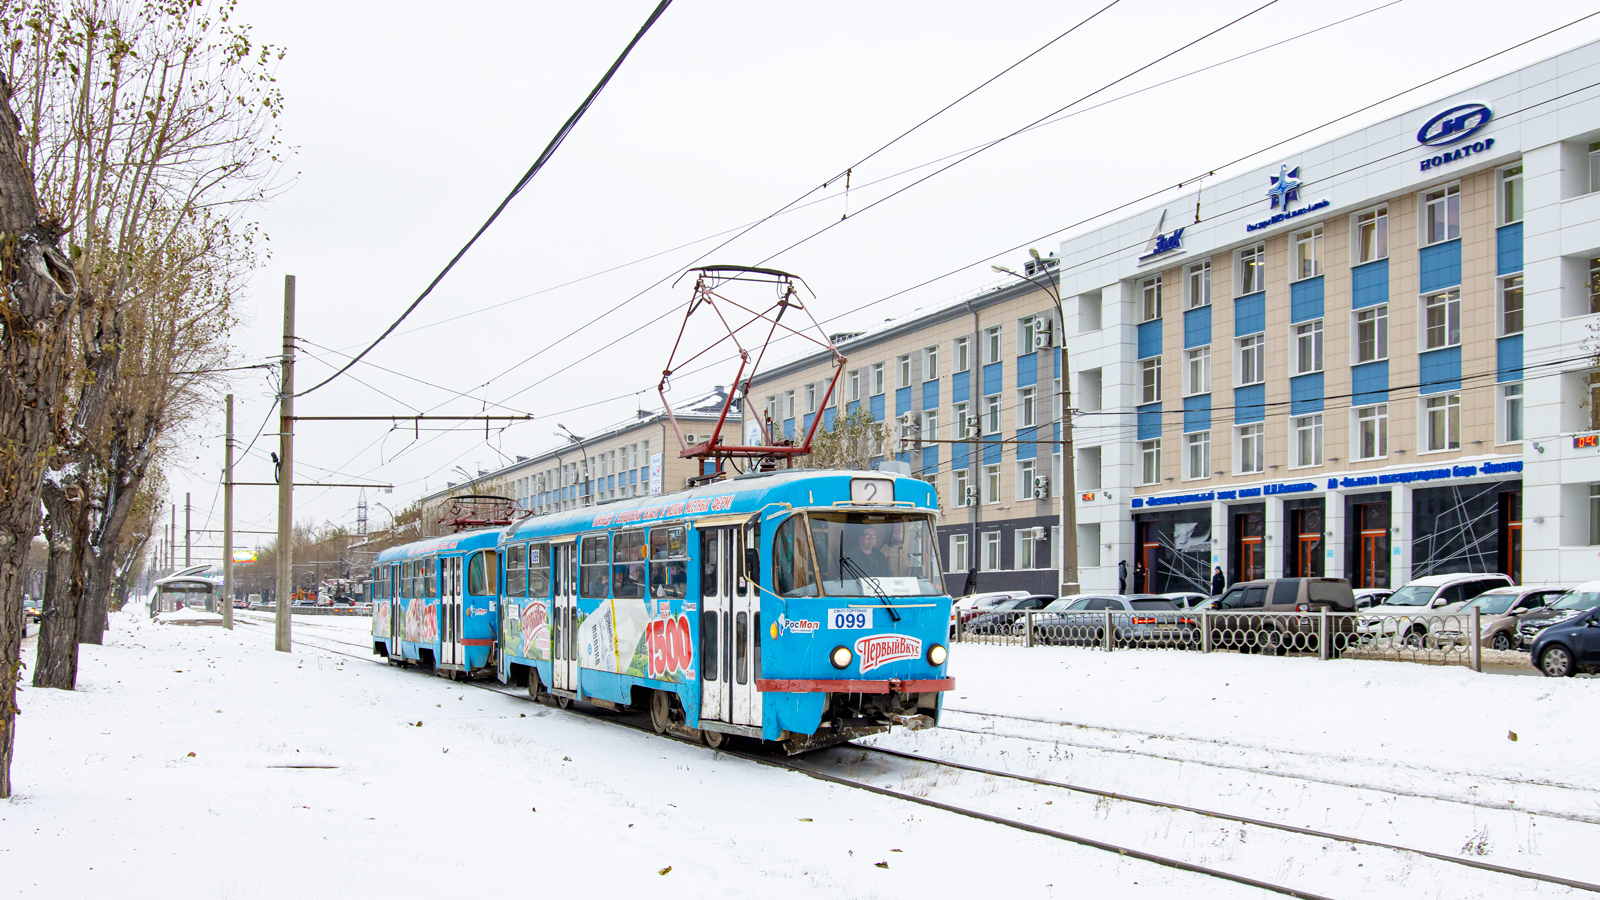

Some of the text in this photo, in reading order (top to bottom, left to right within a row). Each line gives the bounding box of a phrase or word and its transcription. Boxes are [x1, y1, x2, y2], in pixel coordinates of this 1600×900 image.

[1419, 137, 1496, 171] НОВАТОР
[864, 482, 878, 504] 2
[784, 619, 819, 630] РосМол
[835, 613, 866, 629] 099
[645, 616, 692, 676] 1500
